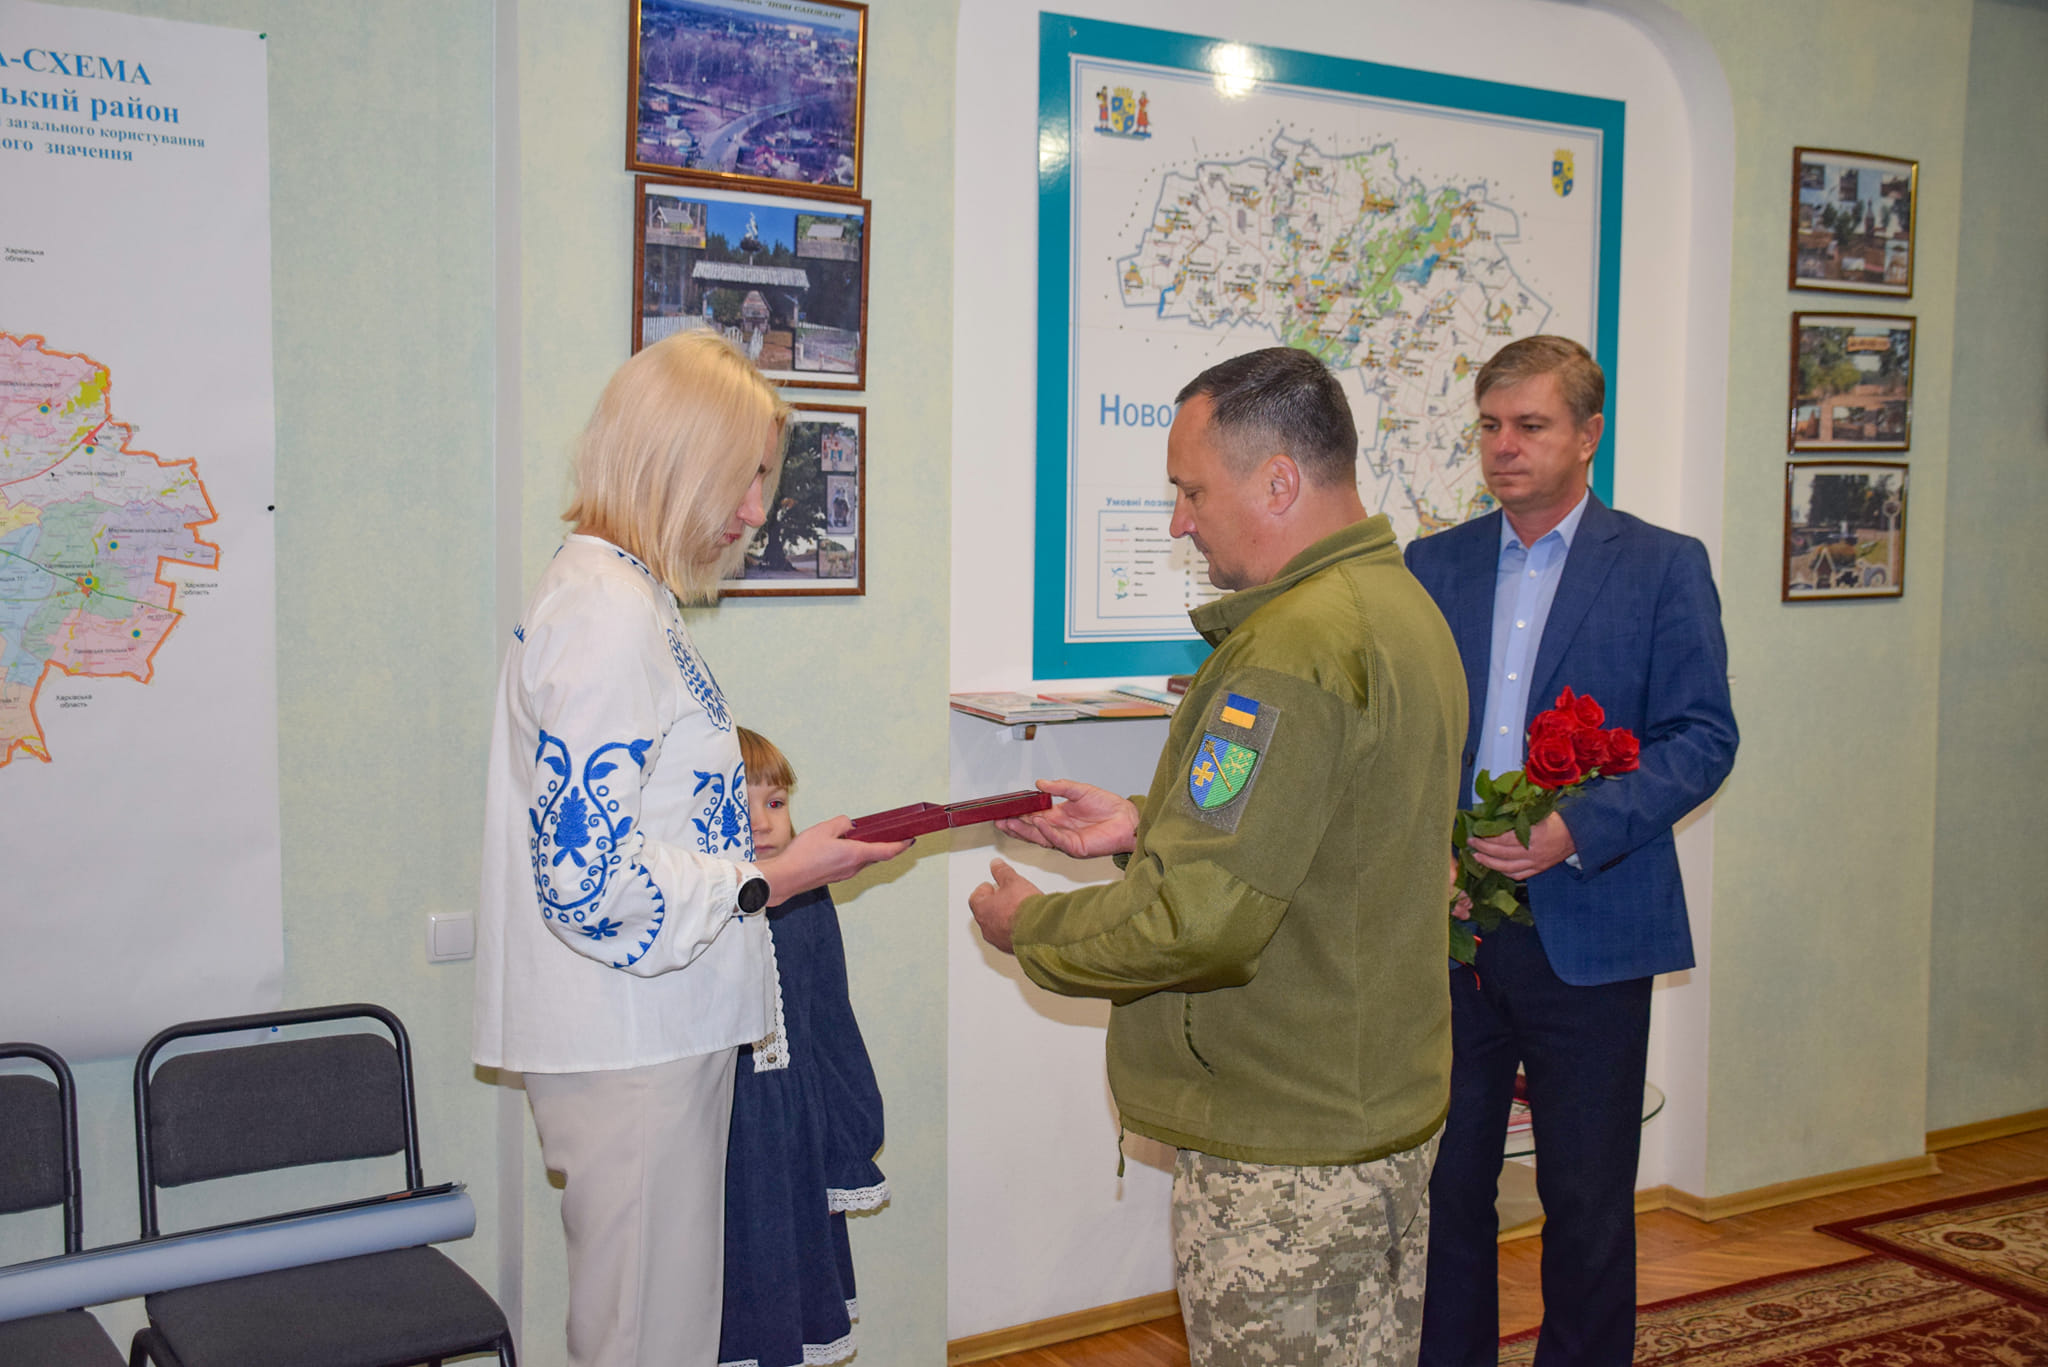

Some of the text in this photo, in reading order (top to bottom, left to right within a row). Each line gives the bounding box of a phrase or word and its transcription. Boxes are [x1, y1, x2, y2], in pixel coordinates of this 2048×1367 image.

[91, 96, 179, 124] район
[7, 118, 205, 148] загального користування
[0, 137, 132, 161] ого значення
[1100, 393, 1180, 428] Ново
[1105, 496, 1176, 507] Умовні позна
